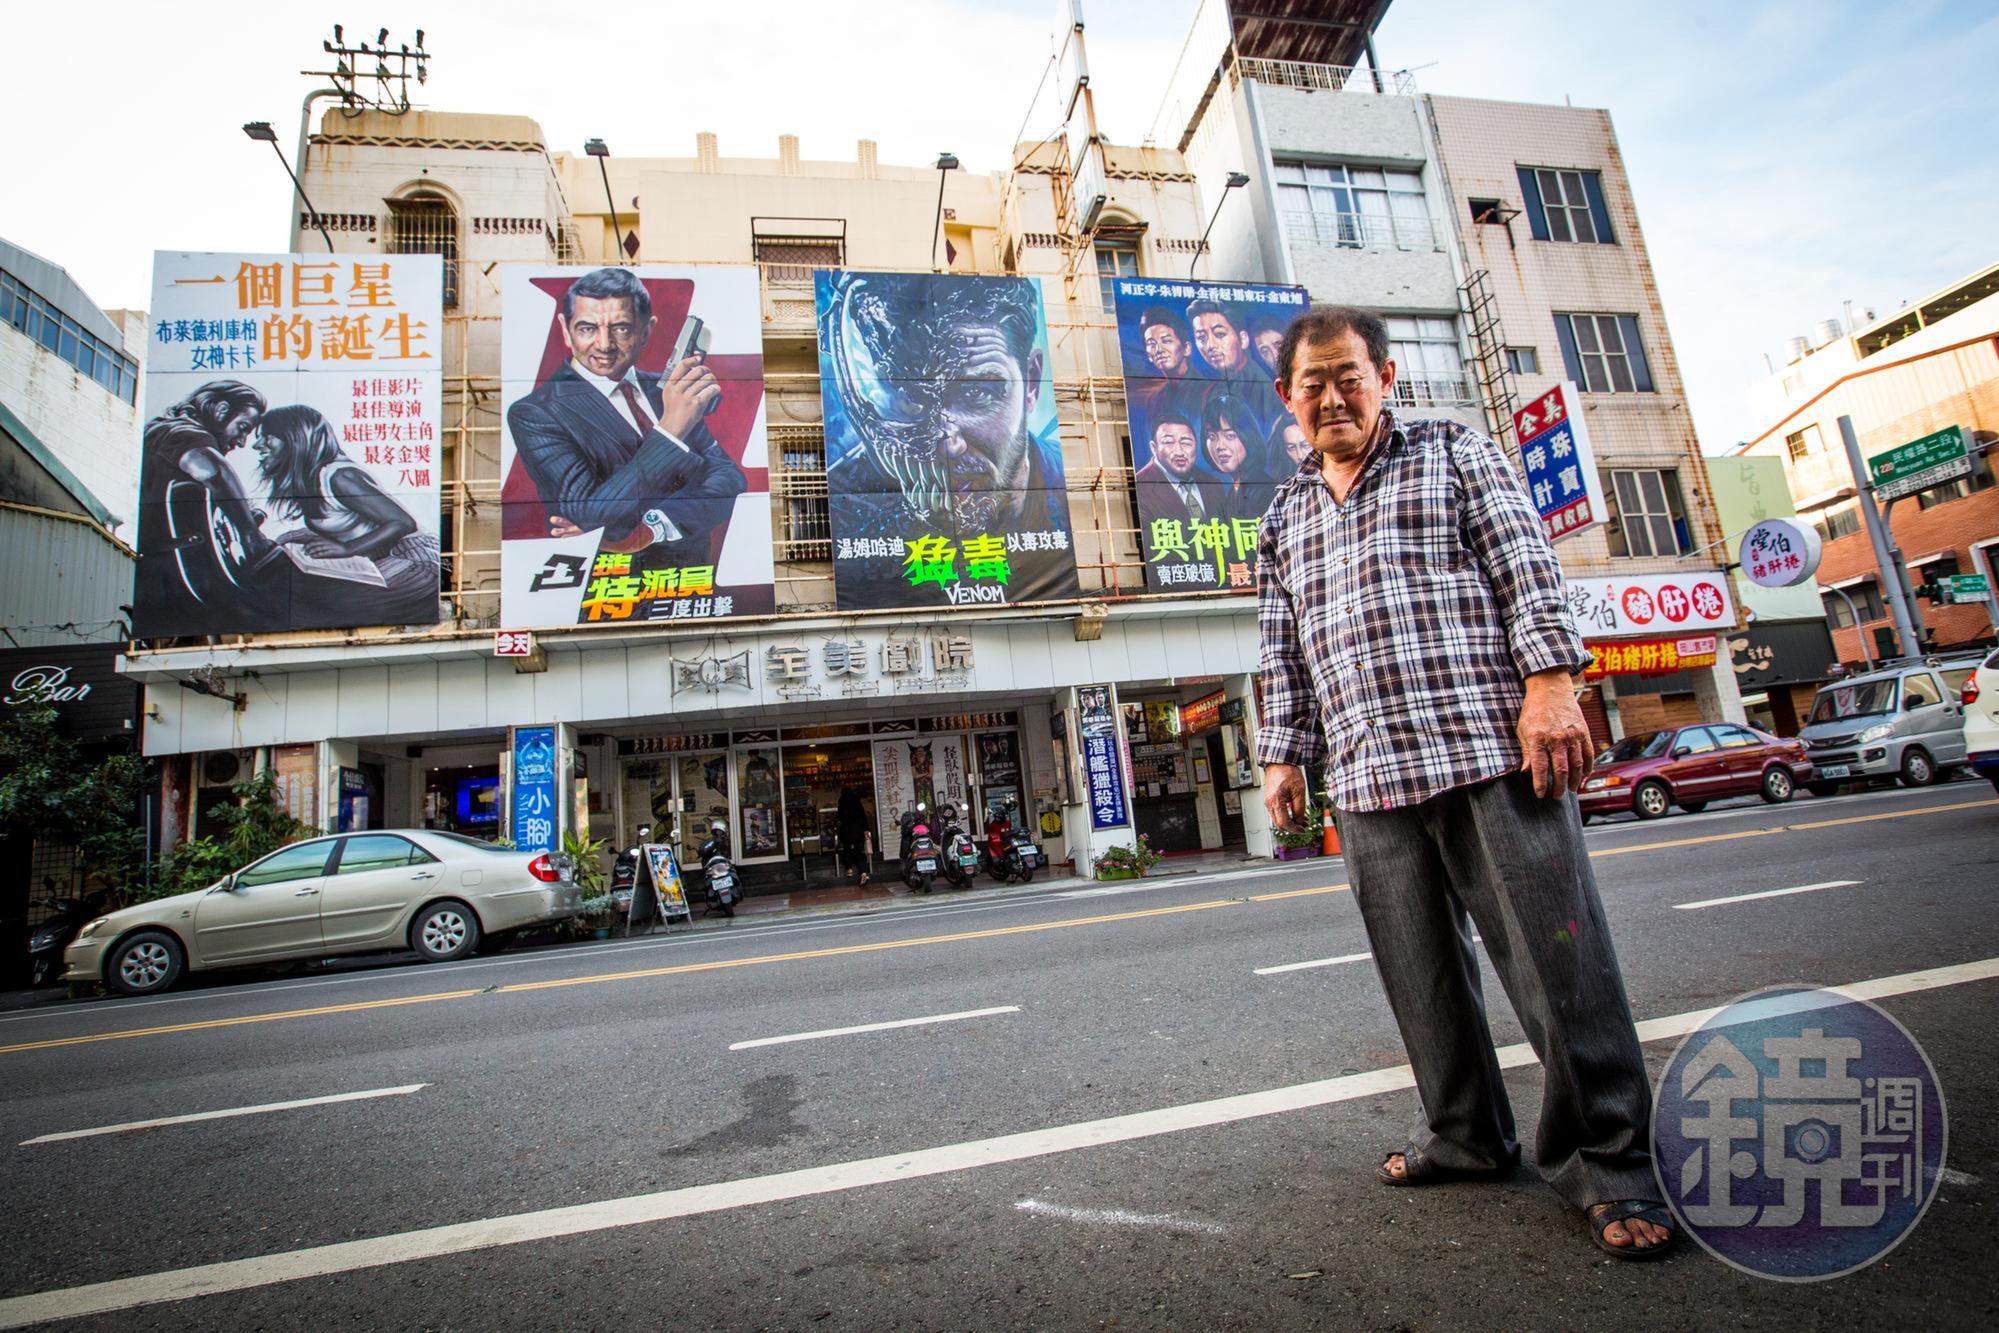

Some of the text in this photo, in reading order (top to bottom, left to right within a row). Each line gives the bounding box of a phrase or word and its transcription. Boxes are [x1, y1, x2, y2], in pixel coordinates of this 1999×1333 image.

[174, 261, 397, 310] 一個巨星
[156, 319, 257, 343] 布萊德利庫柏
[263, 312, 433, 361] 的誕生
[191, 345, 257, 370] 女神卡卡
[352, 378, 423, 398] 最佳影片
[352, 400, 422, 420] 最佳導演
[1519, 394, 1563, 437] 全美
[343, 421, 433, 442] 最佳男女主角
[364, 445, 432, 465] 最多金獎
[1550, 430, 1581, 497] 珠寶
[1525, 445, 1554, 508] 時計
[837, 537, 905, 560] 湯姆哈迪
[1006, 529, 1069, 553] 以毒攻毒
[1751, 528, 1792, 556] 堂伯
[902, 532, 1012, 590] 猛毒
[1753, 553, 1800, 579] 豬肝捲
[1156, 562, 1259, 587] 賣座破億 最
[944, 581, 1007, 605] VENOM
[1625, 584, 1722, 622] 豬肝捲
[649, 596, 734, 621] 三度出擊
[497, 633, 529, 654] 今天
[4, 665, 92, 705] Bar
[1088, 738, 1116, 823] 潛艦獵殺令
